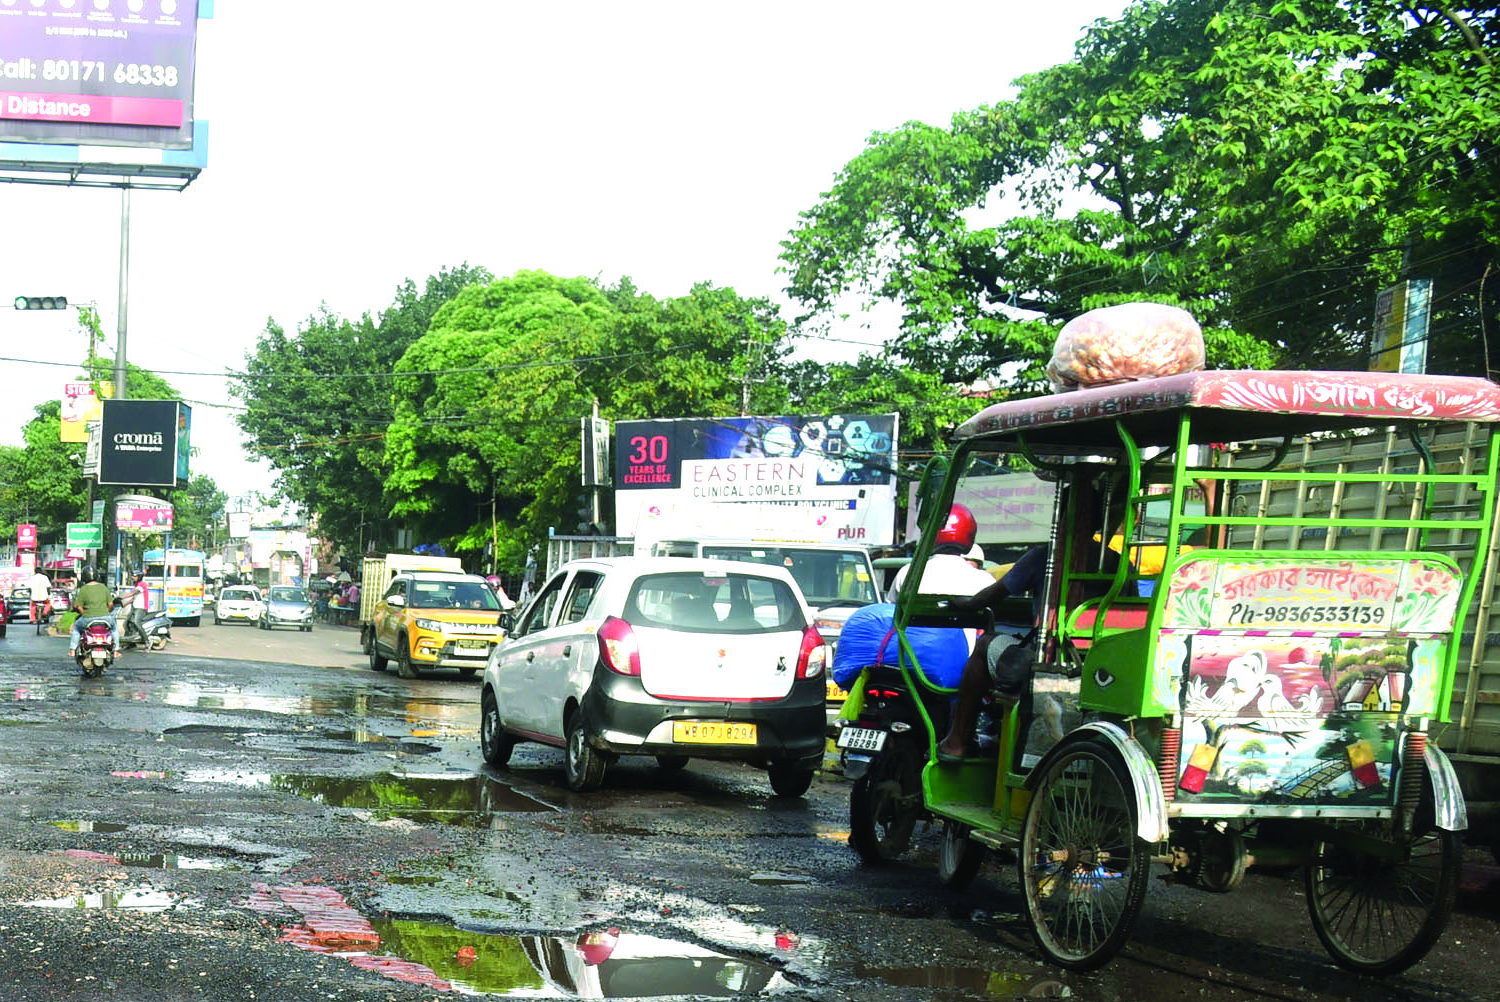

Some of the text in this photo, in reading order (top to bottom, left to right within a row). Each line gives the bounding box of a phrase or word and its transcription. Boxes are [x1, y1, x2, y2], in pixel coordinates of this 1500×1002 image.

[42, 59, 106, 82] 80171
[113, 62, 179, 87] 68338
[8, 96, 91, 117] Distance
[629, 435, 668, 464] 30
[624, 473, 671, 483] EXCELLENCE
[629, 464, 666, 475] YEARS OF
[693, 462, 805, 483] EASTERN
[693, 483, 802, 498] CLINICAL COMPLEX
[1228, 603, 1385, 624] Ph-9836533139
[726, 727, 754, 741] 8294
